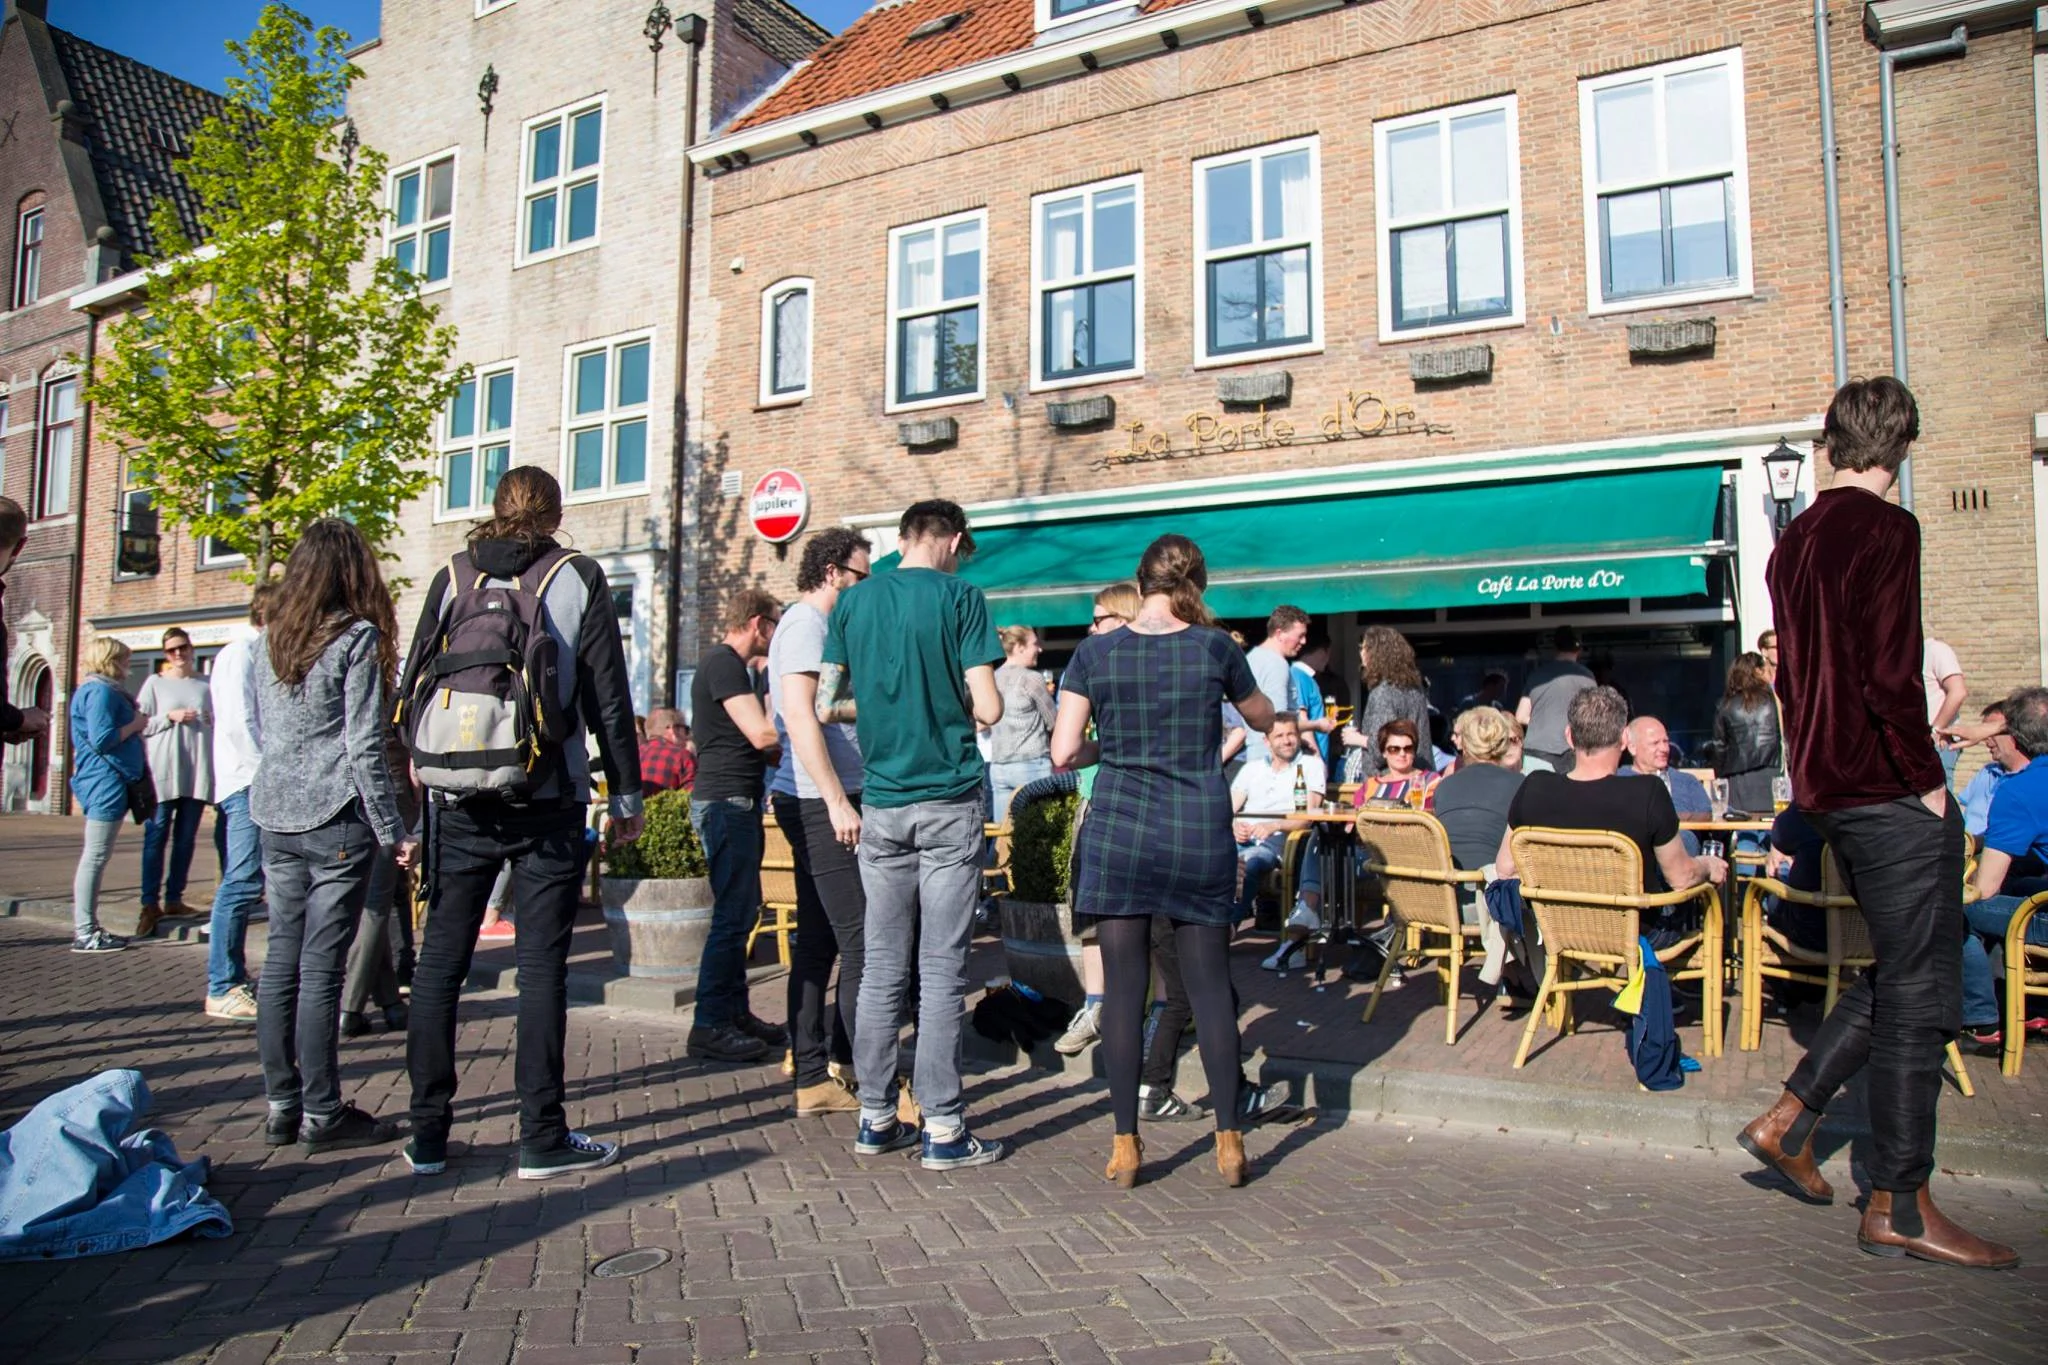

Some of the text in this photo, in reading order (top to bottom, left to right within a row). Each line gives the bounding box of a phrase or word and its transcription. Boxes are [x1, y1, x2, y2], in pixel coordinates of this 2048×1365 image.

[1110, 388, 1413, 457] La Porte d'Or
[1477, 569, 1624, 599] Café La Porte d'Or
